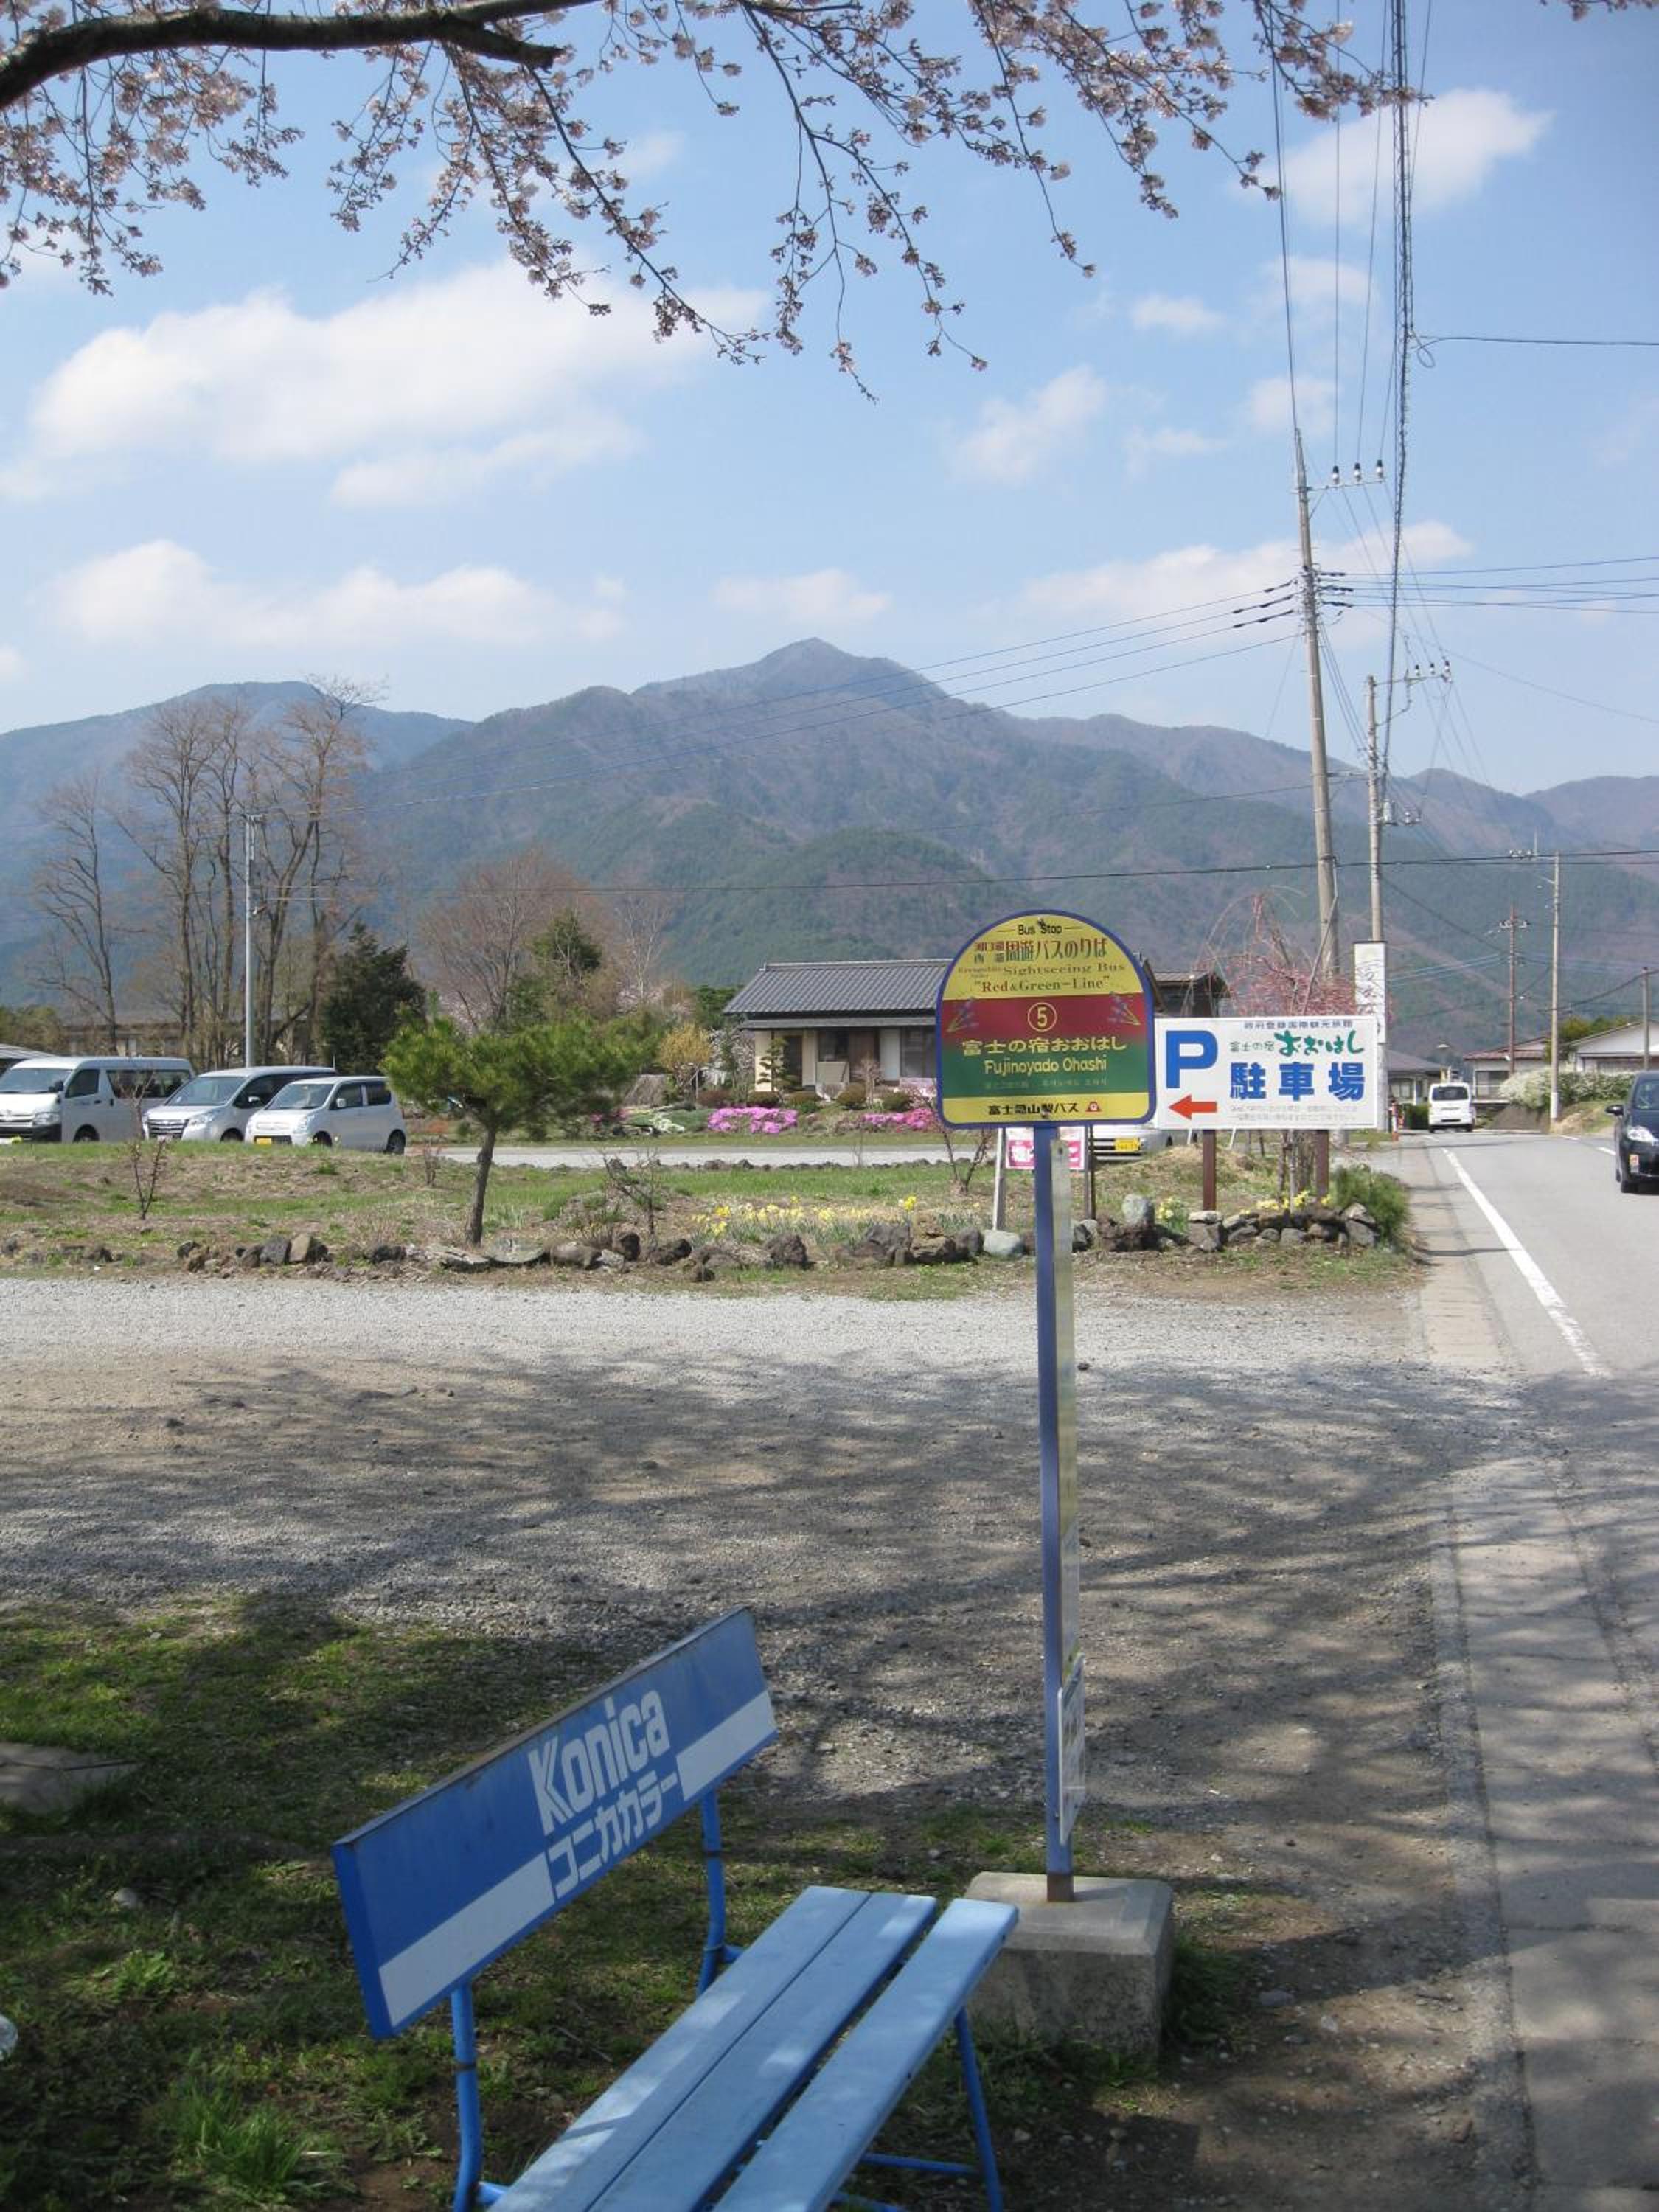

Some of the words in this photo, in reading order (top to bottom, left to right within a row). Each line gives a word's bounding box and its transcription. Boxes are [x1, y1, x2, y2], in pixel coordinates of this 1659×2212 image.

[1018, 924, 1036, 935] Bus
[1040, 923, 1062, 934] Stop
[1002, 964, 1093, 977] Sightseeing
[1097, 961, 1127, 973] Bus
[961, 1036, 1127, 1057] 富士の宿おおはし
[1165, 1030, 1219, 1089] P
[984, 1057, 1060, 1076] Fujinoyado
[1062, 1054, 1107, 1072] Ohashi
[1229, 1061, 1366, 1102] 駐車場
[528, 1689, 671, 1836] Konica
[548, 1768, 679, 1900] コニカカラー
